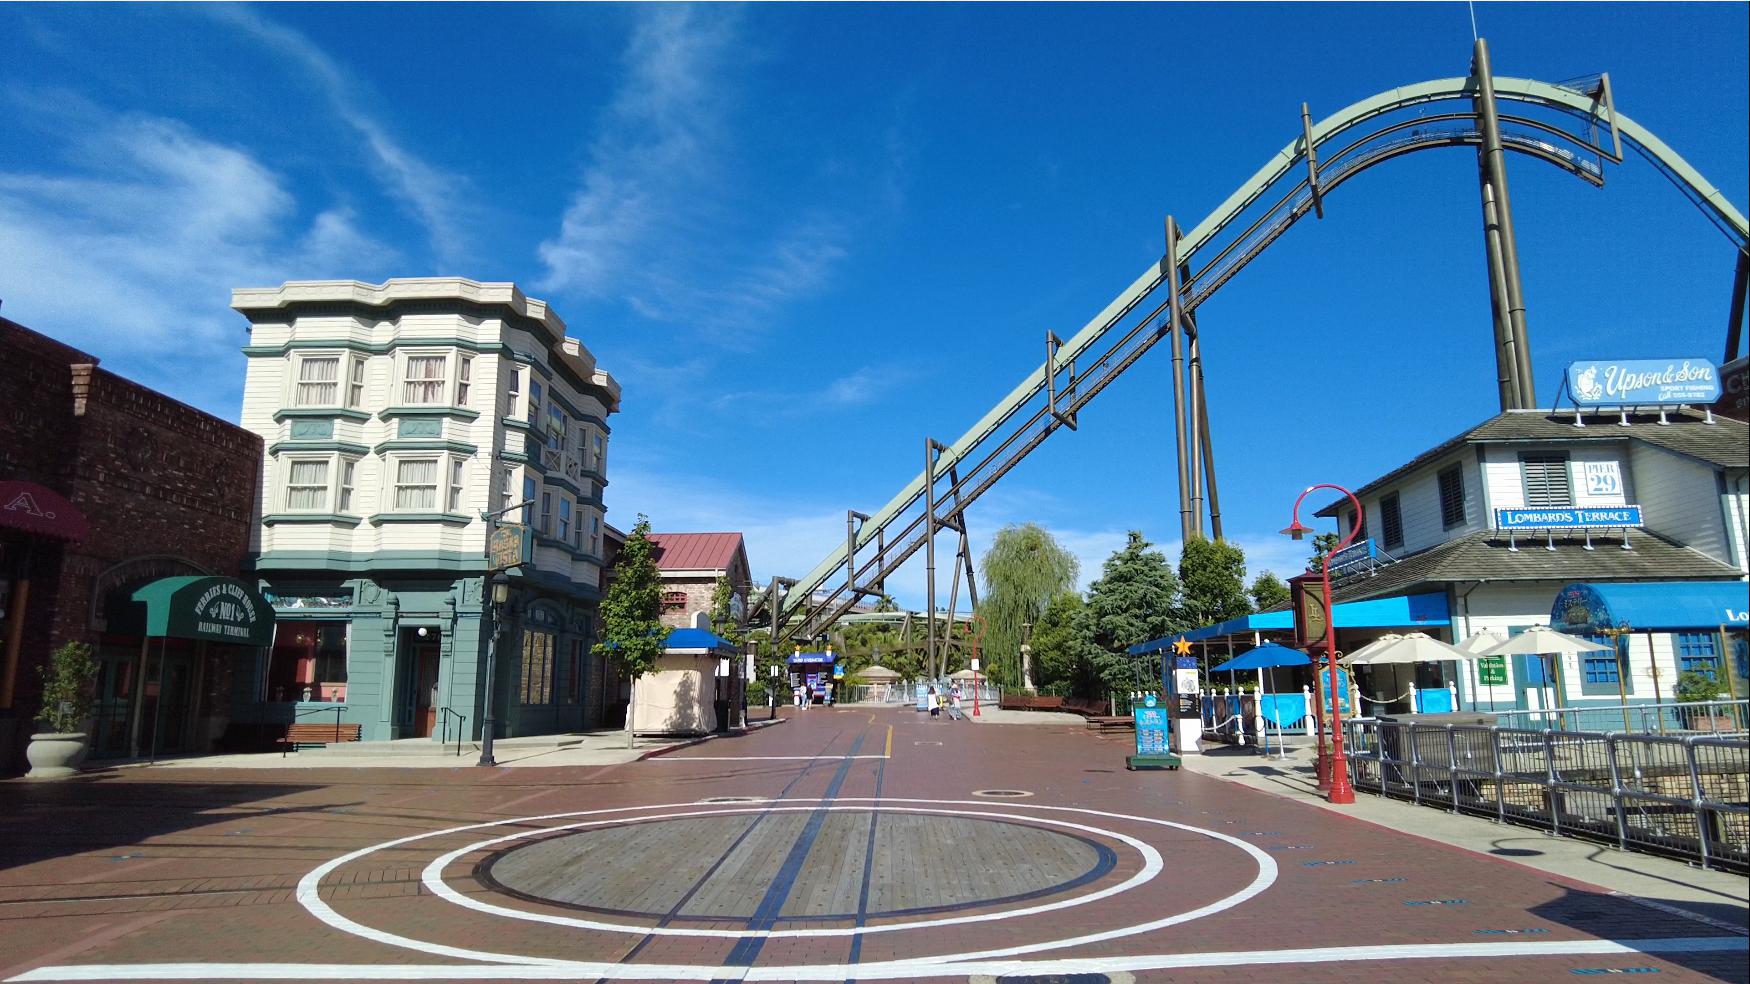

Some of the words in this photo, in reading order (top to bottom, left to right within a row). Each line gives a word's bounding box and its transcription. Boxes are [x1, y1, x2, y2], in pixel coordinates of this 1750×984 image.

[1605, 366, 1661, 399] Upson
[1675, 361, 1712, 382] Son
[1588, 464, 1615, 473] PIER
[1590, 474, 1617, 492] 29
[1506, 511, 1574, 524] LOMBARD'S
[1575, 511, 1631, 524] TERRACE
[194, 584, 221, 615] FERRIES
[221, 583, 227, 595] &
[227, 583, 245, 600] CLIFF
[241, 593, 257, 624] HOUSE
[198, 621, 222, 634] RAILWAY
[223, 624, 250, 638] TERMINAL
